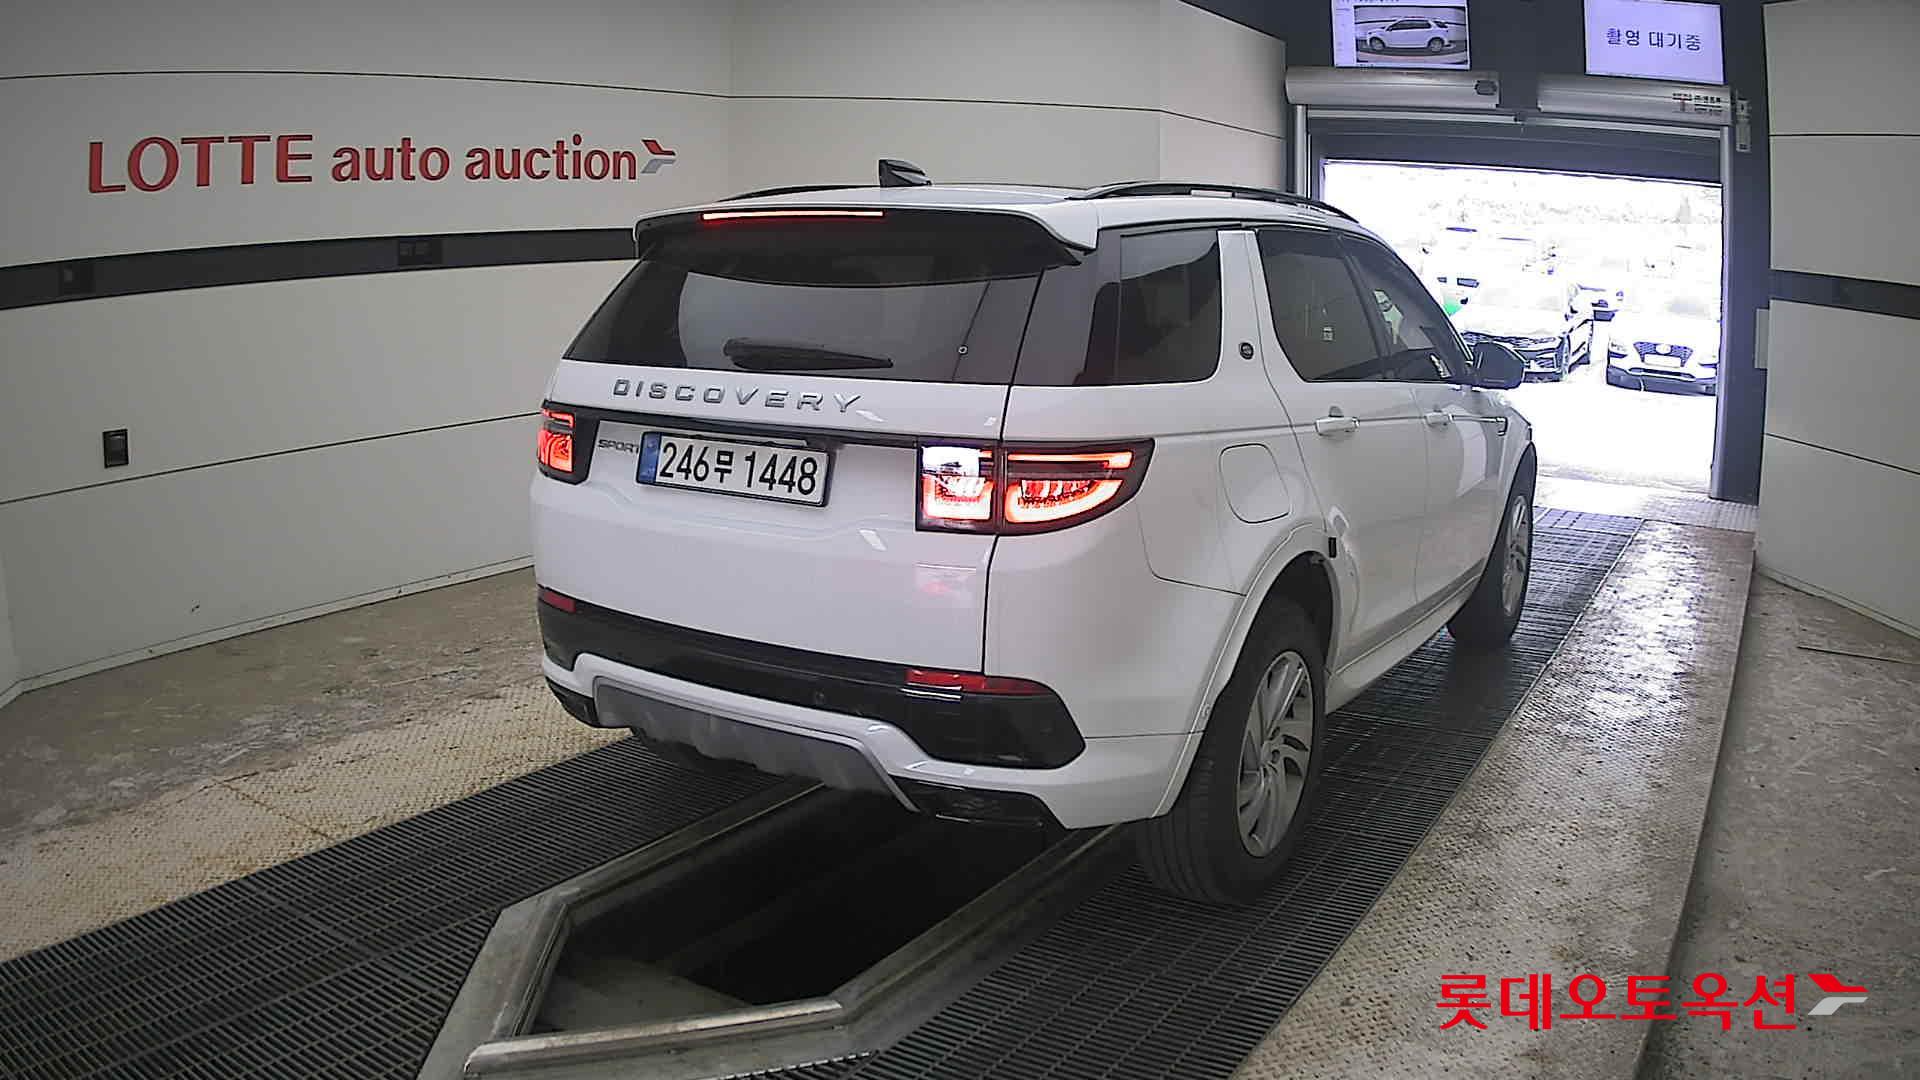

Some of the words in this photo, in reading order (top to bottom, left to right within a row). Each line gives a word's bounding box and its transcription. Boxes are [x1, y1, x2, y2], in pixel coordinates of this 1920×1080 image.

[1606, 27, 1640, 47] 촬영
[1648, 31, 1702, 52] 대기중
[88, 134, 313, 194] LOTTE
[330, 137, 451, 183] auto
[463, 134, 638, 182] auction
[613, 378, 861, 413] DISCOVERY
[659, 441, 735, 484] 246무
[744, 450, 819, 496] 1448
